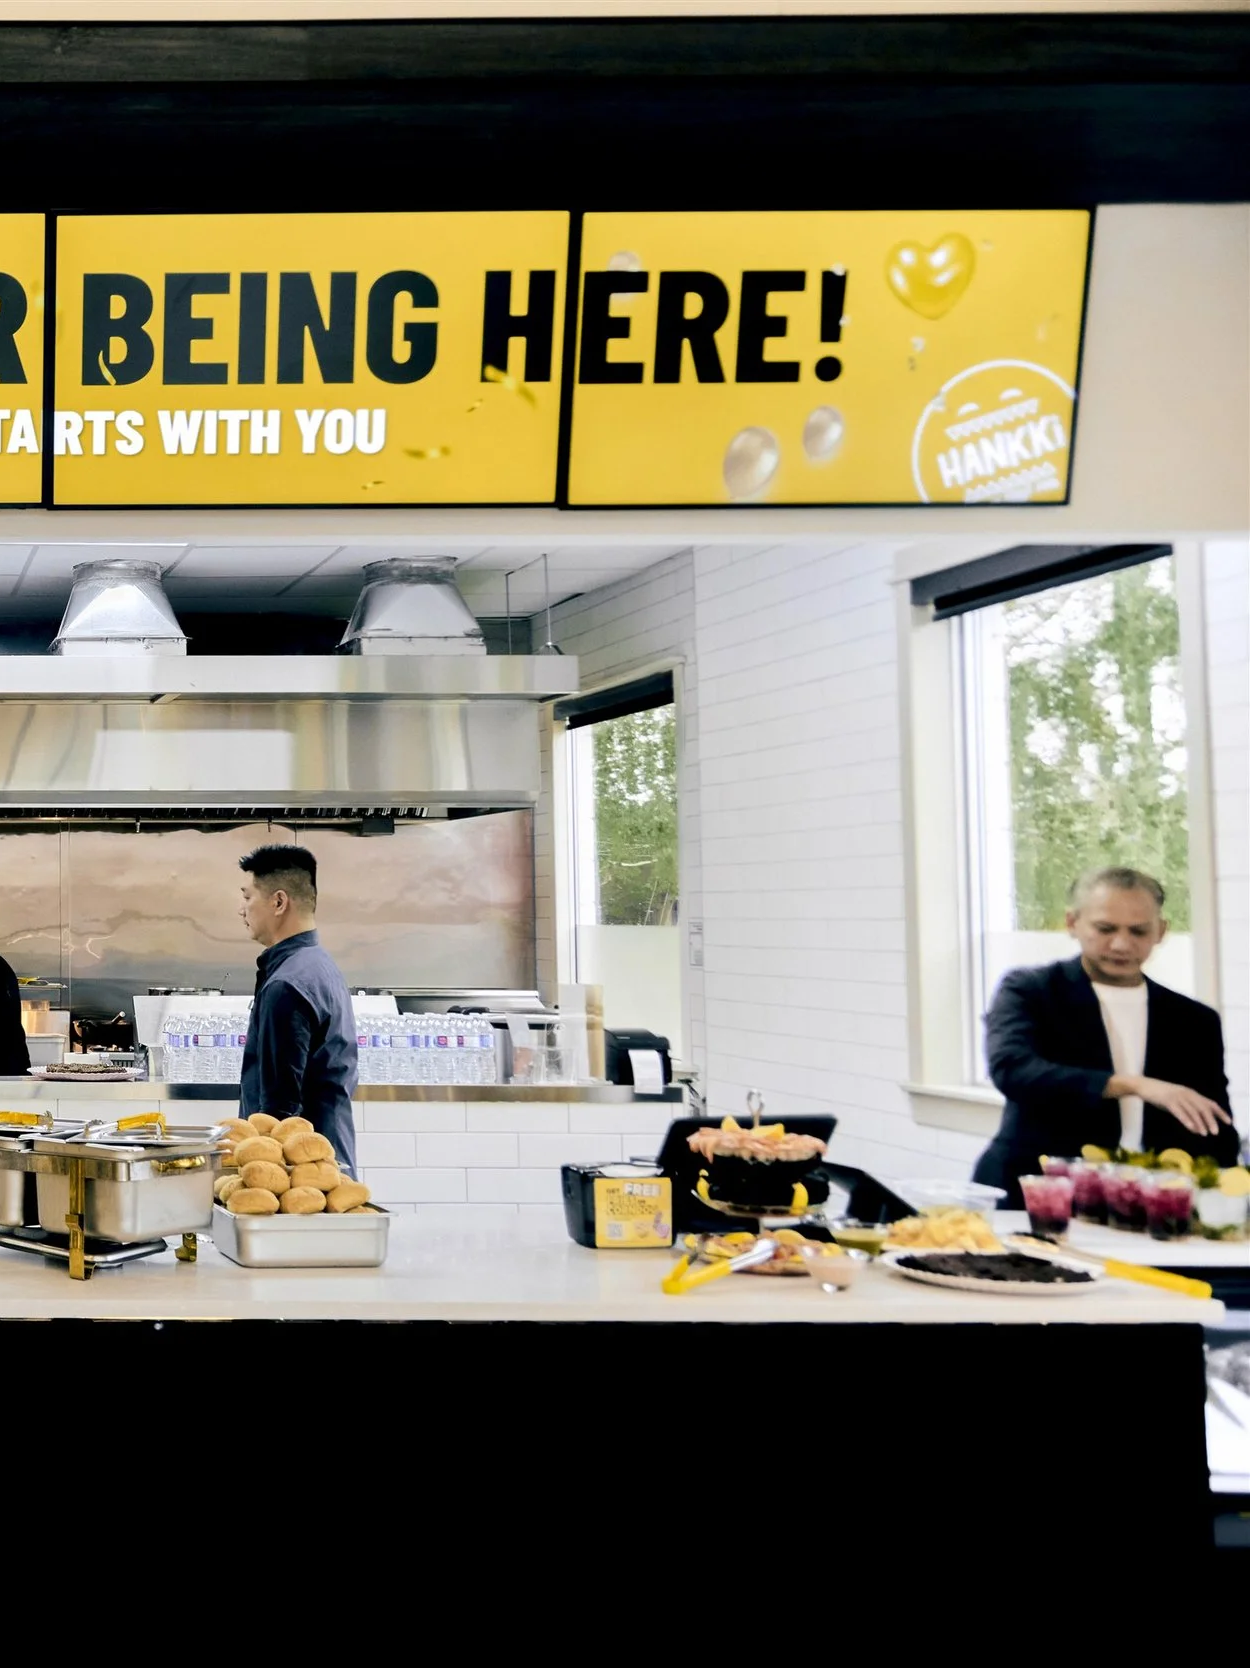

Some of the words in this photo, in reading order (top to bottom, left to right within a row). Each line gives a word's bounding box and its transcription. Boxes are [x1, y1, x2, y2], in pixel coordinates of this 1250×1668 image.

[81, 270, 440, 386] BEING
[480, 270, 849, 384] HERE!
[157, 408, 282, 456] WITH
[294, 407, 387, 455] YOU
